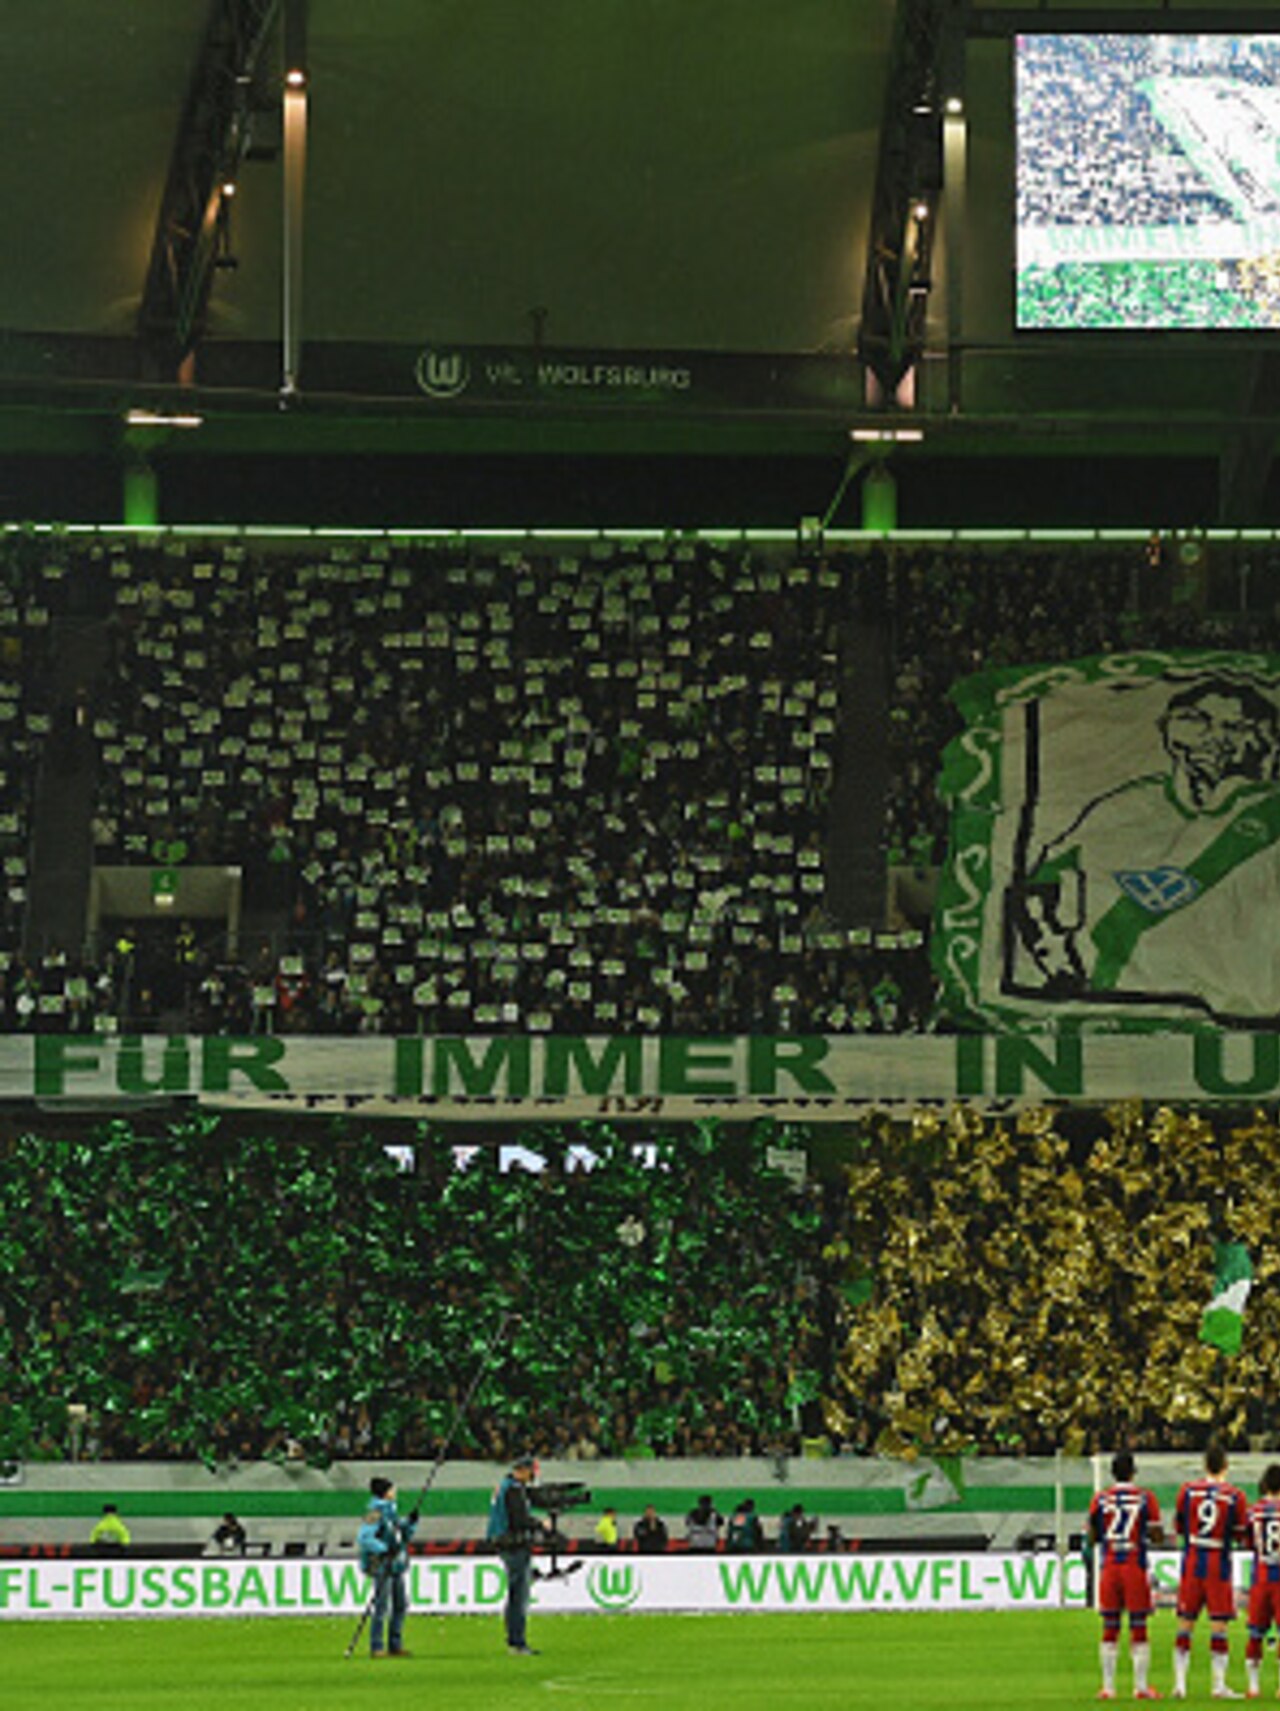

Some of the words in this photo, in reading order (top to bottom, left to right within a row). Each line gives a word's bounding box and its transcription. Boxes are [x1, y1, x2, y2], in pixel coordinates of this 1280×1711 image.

[537, 364, 691, 389] WOLFSBURG
[395, 1035, 836, 1096] IMMER
[955, 1035, 1083, 1096] IN
[1103, 1503, 1142, 1539] 27
[1198, 1499, 1219, 1535] 9
